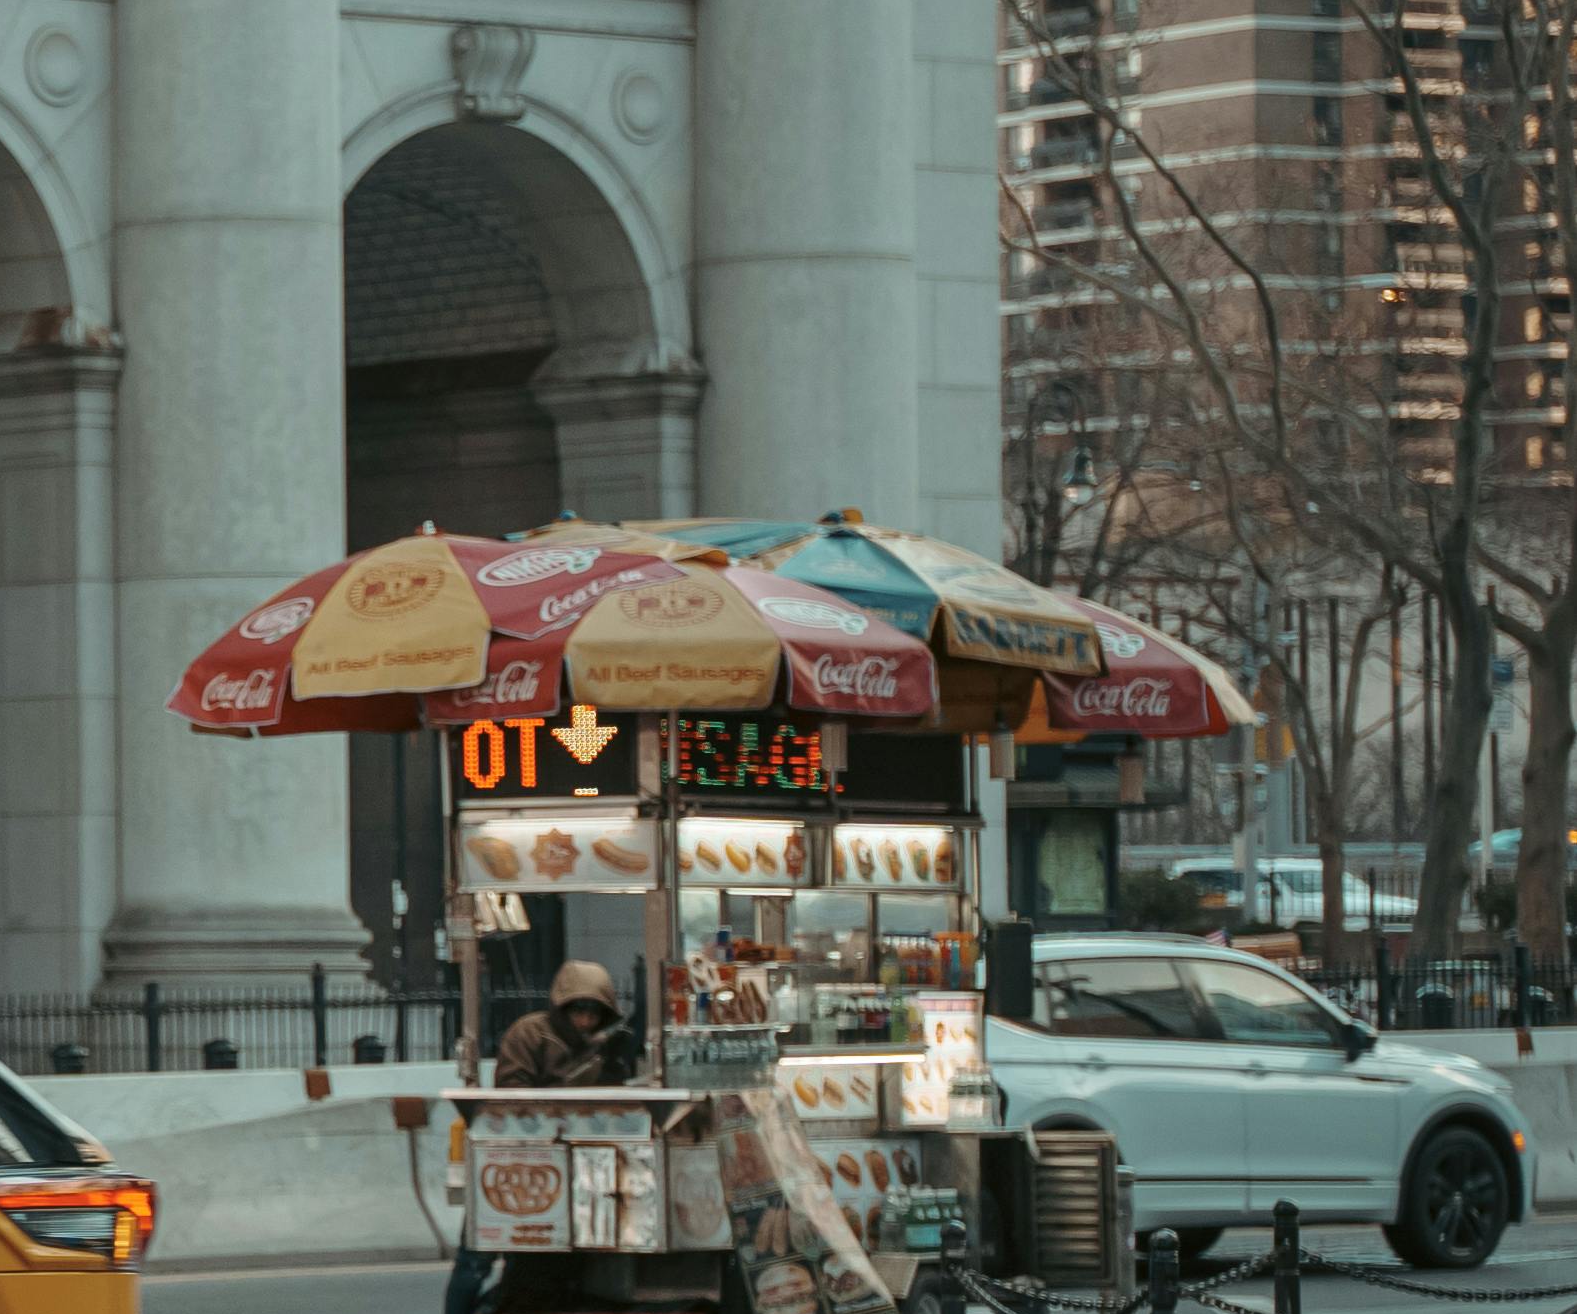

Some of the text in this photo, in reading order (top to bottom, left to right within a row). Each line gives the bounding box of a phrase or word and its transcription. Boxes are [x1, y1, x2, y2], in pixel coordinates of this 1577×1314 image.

[382, 646, 475, 666] Sausages
[617, 663, 661, 682] Beef
[667, 663, 766, 686] Sausages
